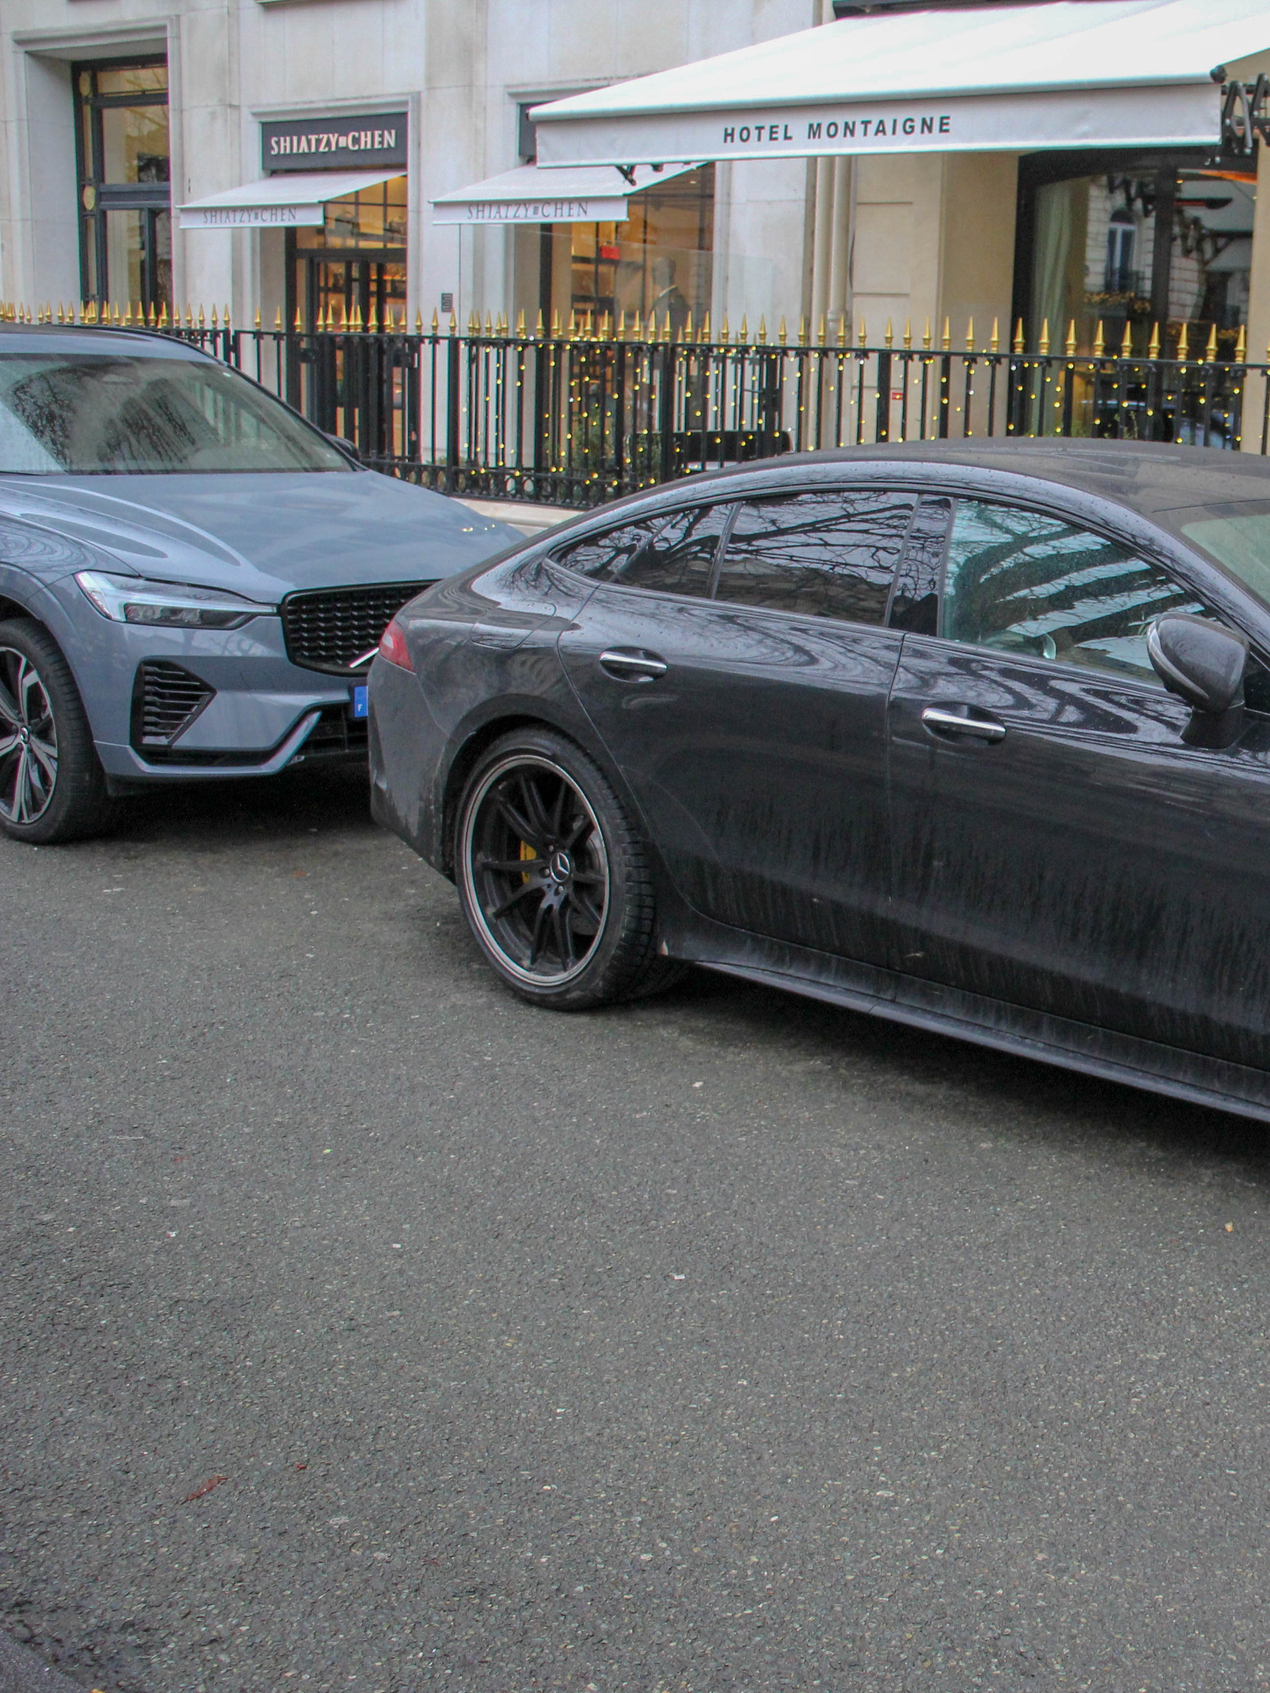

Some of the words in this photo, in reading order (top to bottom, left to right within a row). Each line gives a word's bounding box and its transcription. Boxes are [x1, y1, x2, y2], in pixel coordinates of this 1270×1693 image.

[723, 124, 793, 143] HOTEL
[807, 115, 951, 140] MONTAIGNE
[270, 133, 339, 155] SHIATZY
[348, 129, 396, 150] CHEN
[203, 207, 254, 224] SHIATZY
[260, 206, 298, 222] CHEN
[467, 202, 531, 219] SHIATZY
[541, 201, 589, 218] CHEN
